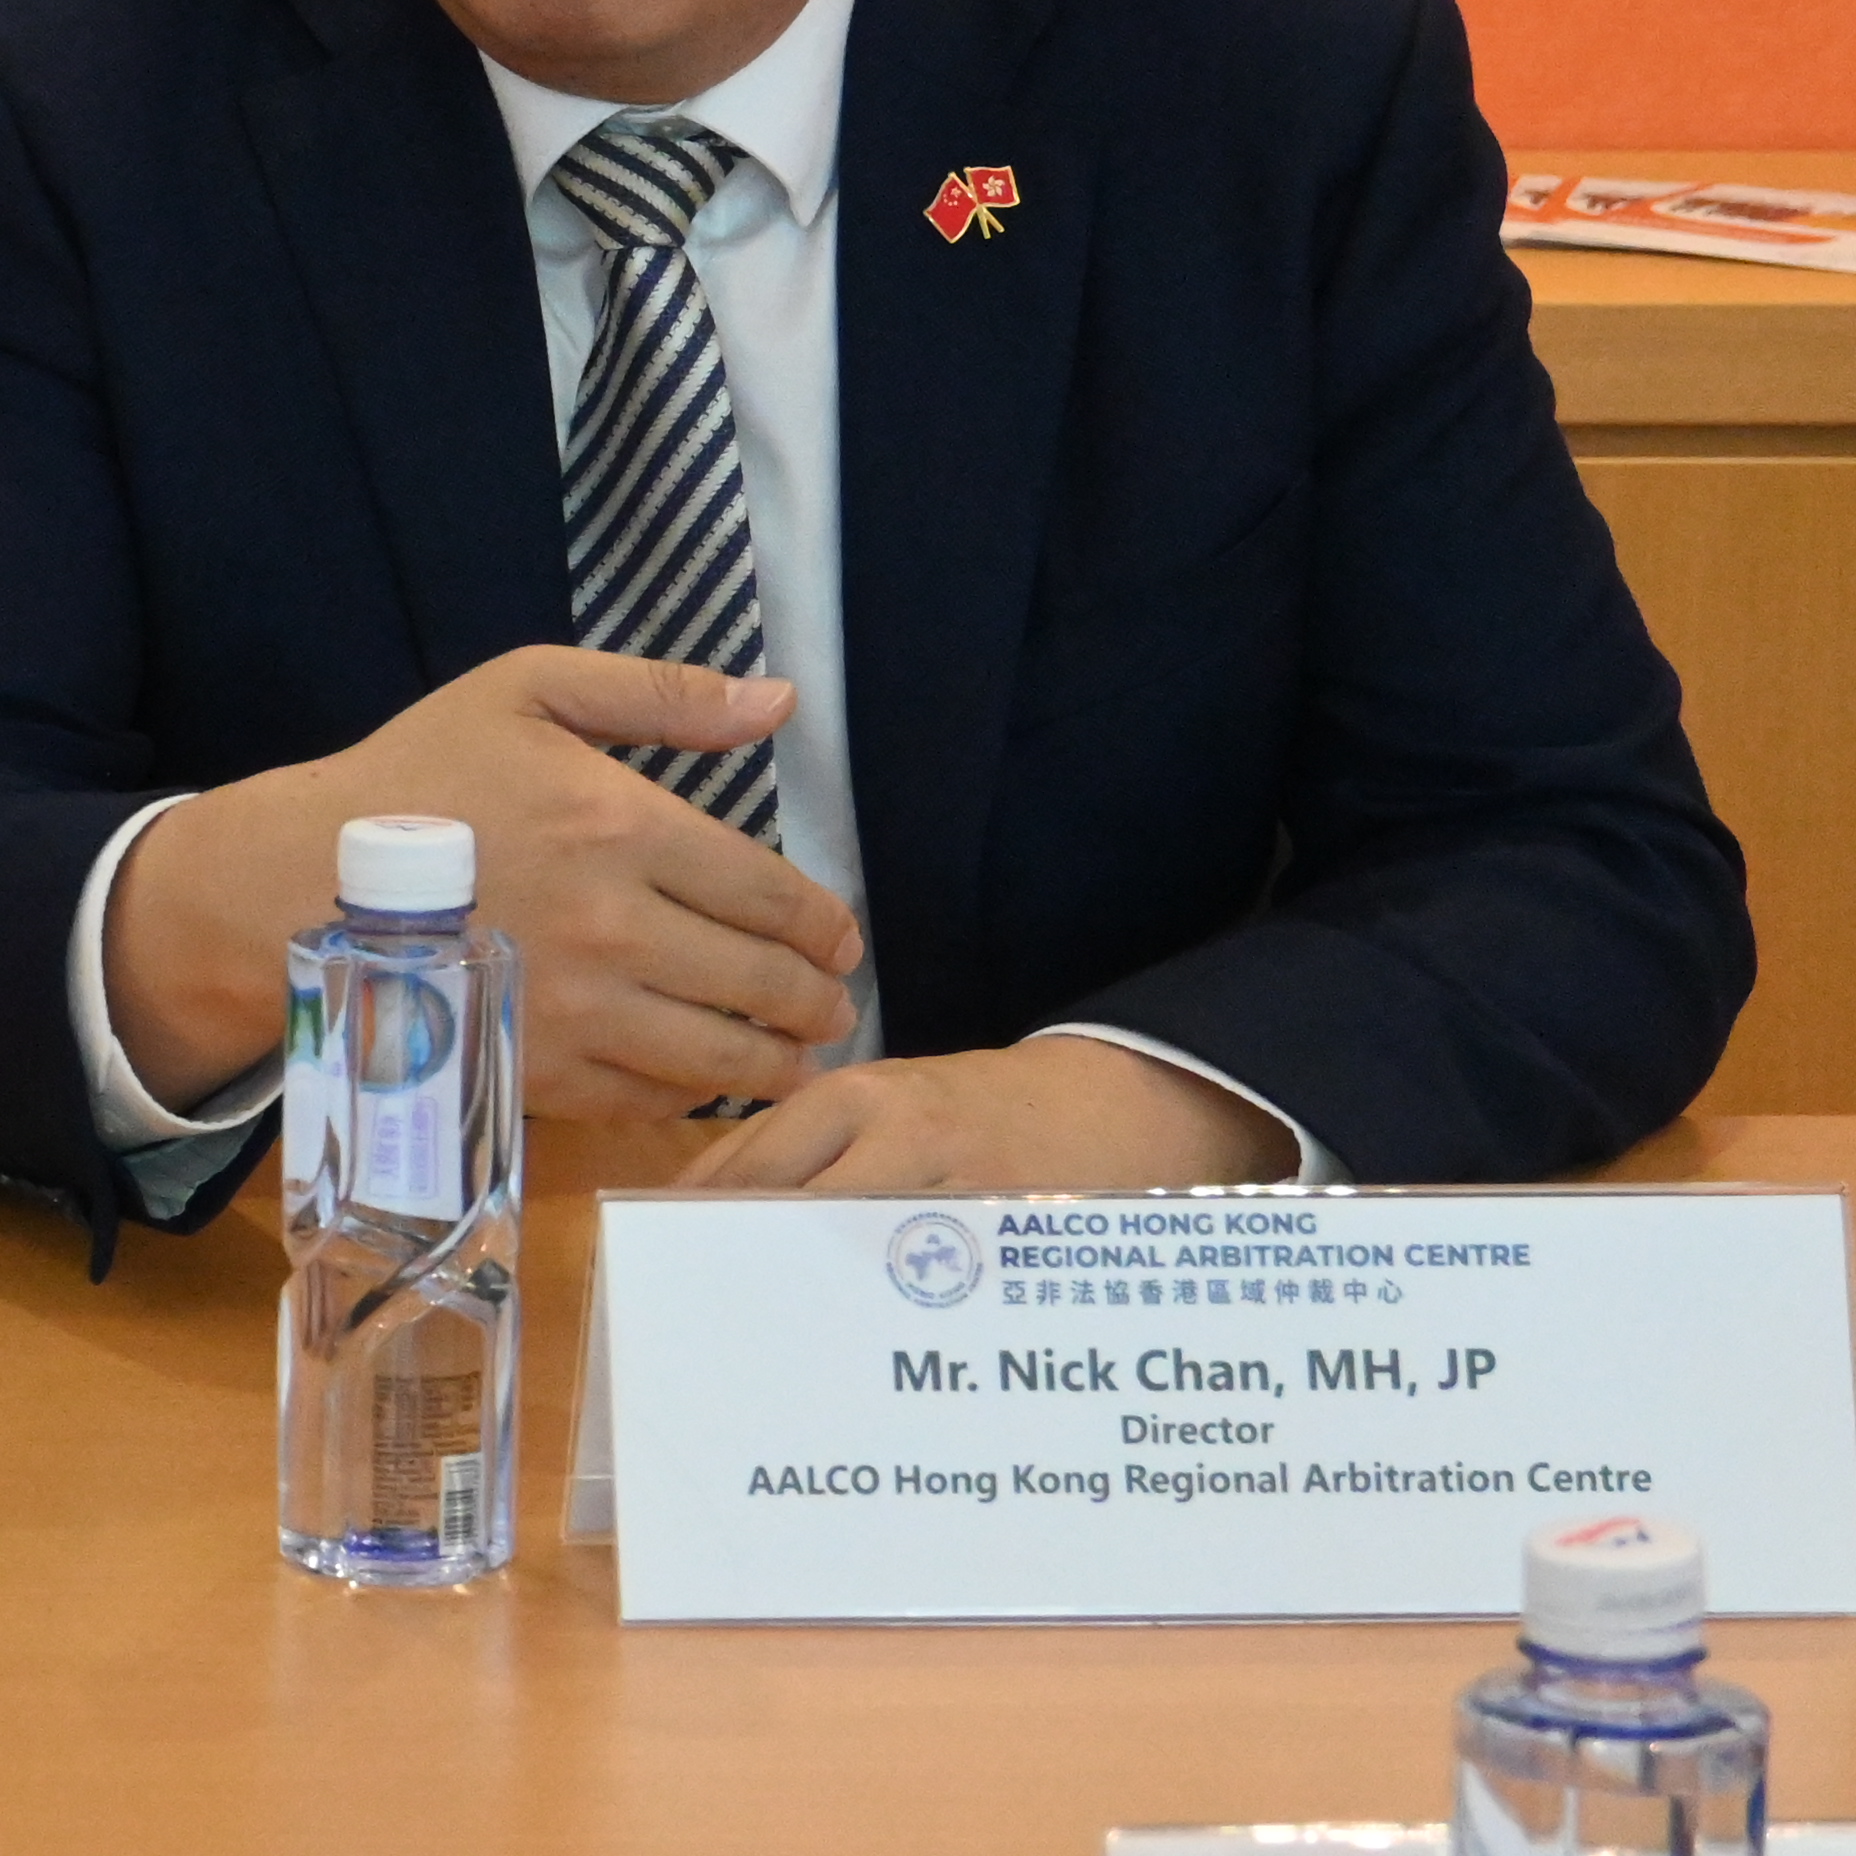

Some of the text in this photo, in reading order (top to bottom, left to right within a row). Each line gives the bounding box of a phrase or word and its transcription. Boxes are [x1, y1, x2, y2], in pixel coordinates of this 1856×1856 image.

[997, 1212, 1317, 1237] AALCO HONG KONG
[1000, 1243, 1530, 1269] REGIONAL ARBITRATION CENTRE
[892, 1346, 1497, 1399] Mr. Nick Chan, MH, JP
[1120, 1413, 1275, 1445] Director
[748, 1461, 1653, 1502] AALCO Hong Kong Regional Arbitration Centre
